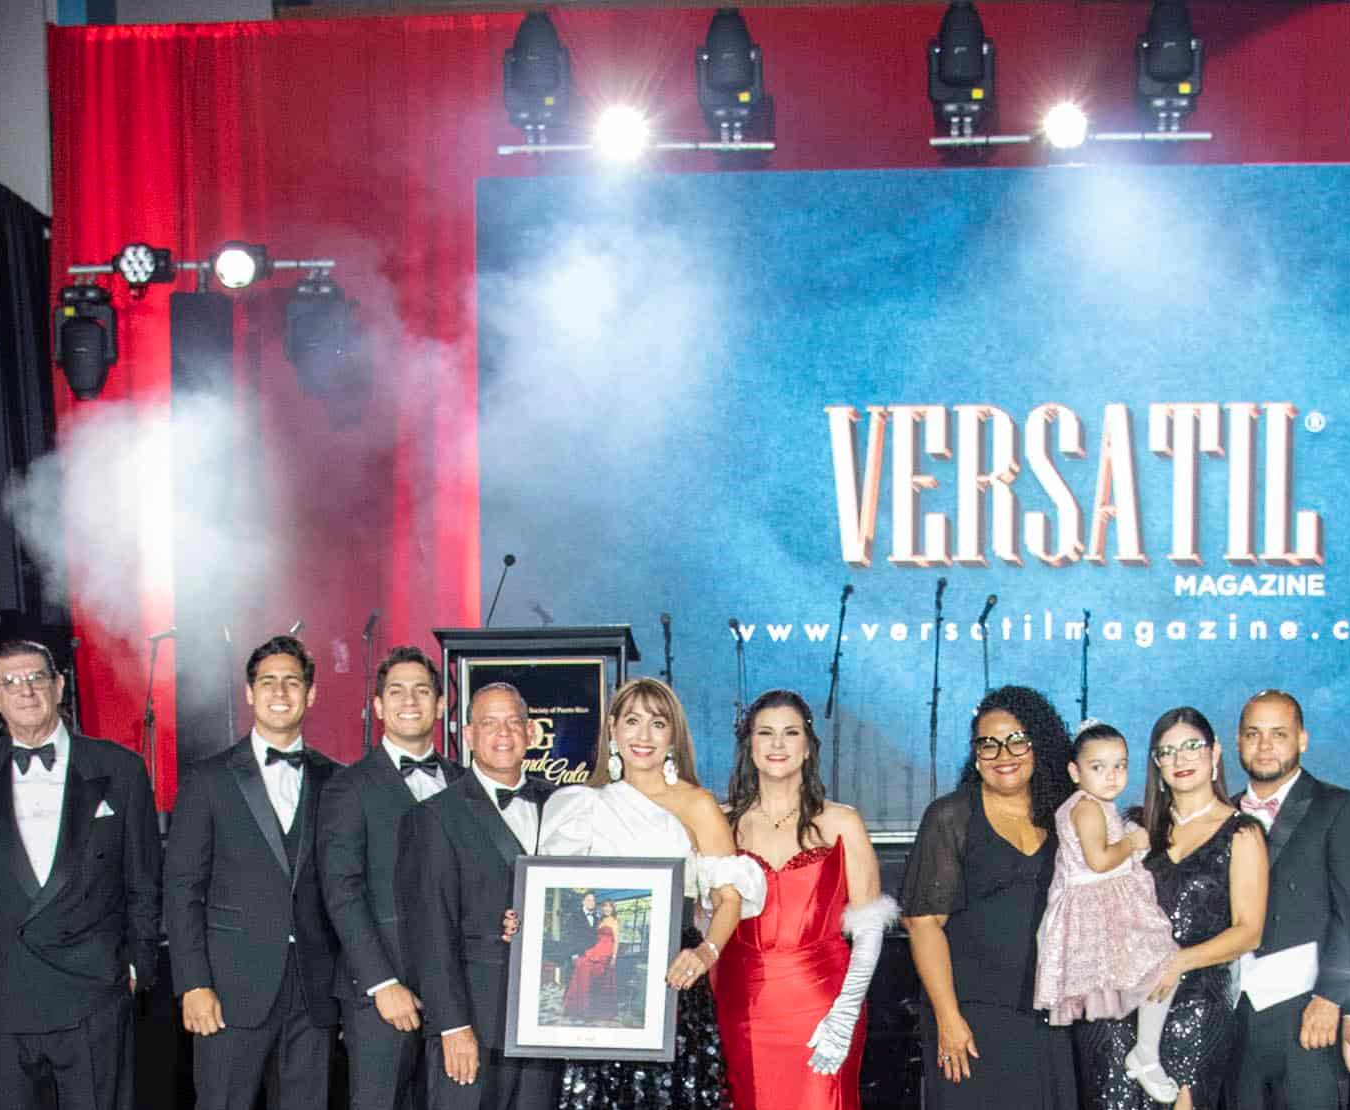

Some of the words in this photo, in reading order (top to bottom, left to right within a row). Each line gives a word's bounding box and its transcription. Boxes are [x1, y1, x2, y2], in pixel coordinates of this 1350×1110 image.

[825, 403, 1326, 567] VERSATIL
[1174, 574, 1326, 598] MAGAZINE
[545, 758, 589, 785] Gala
